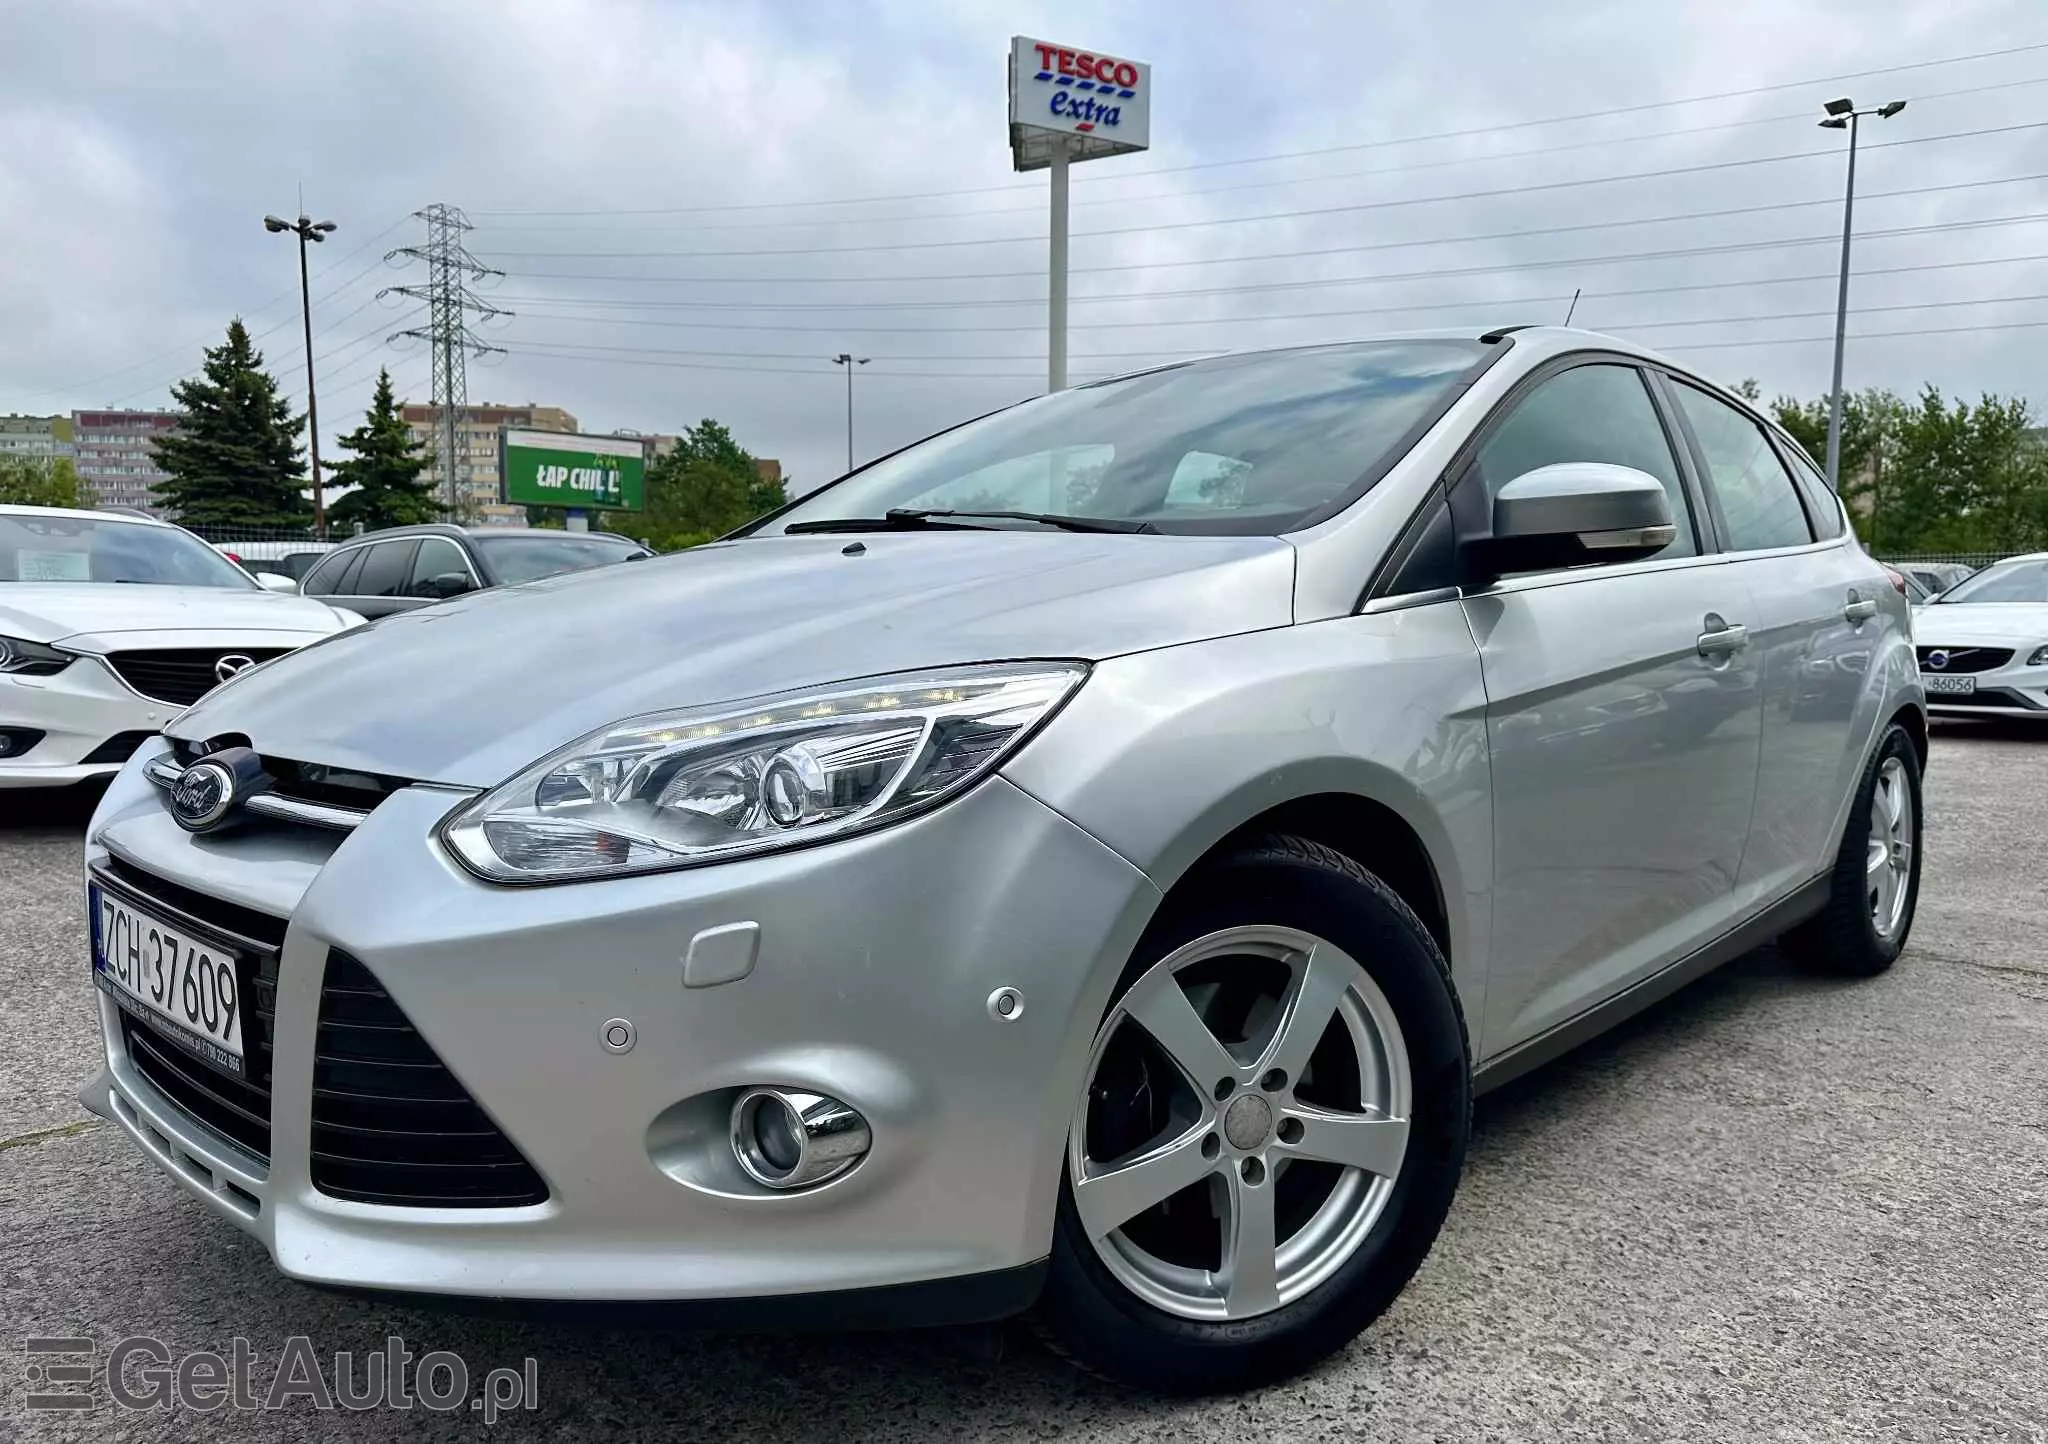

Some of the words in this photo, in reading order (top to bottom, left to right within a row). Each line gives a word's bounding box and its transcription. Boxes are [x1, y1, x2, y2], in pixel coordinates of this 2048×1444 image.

[1034, 41, 1138, 87] TESCO
[1049, 90, 1121, 126] extra
[536, 465, 568, 488] ŁAP
[1932, 678, 1972, 690] 86056
[171, 771, 213, 809] Ford
[103, 899, 141, 993] ZCH
[150, 928, 237, 1040] 37609
